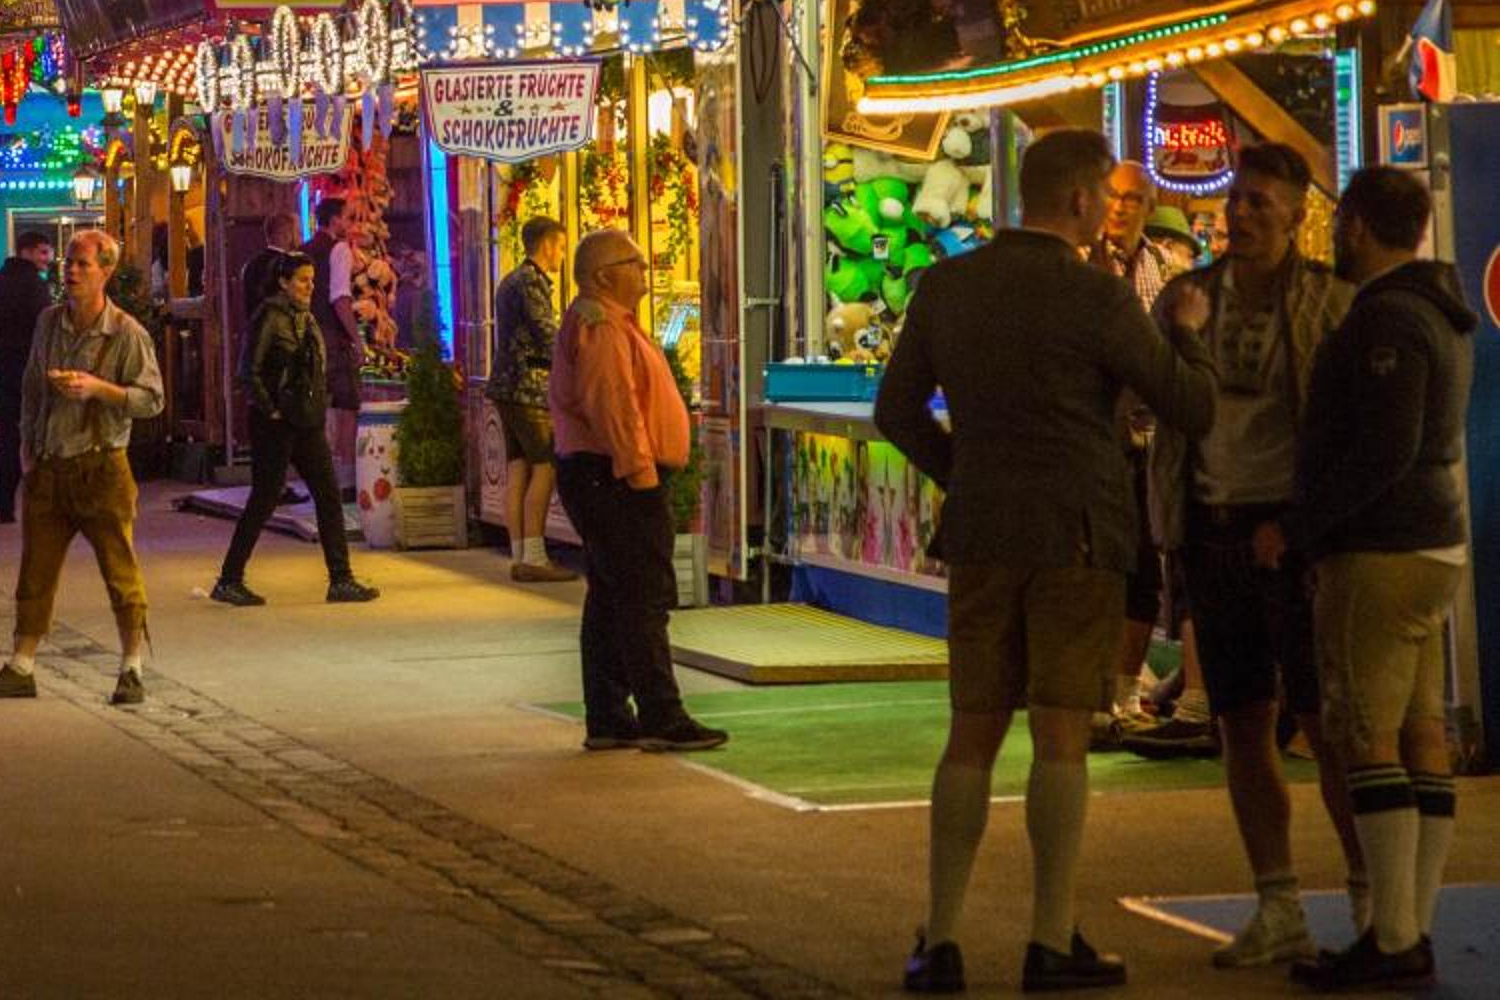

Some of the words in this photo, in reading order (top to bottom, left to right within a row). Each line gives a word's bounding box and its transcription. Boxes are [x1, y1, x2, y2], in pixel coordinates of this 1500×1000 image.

[435, 75, 513, 104] GLASIERTE
[519, 69, 585, 100] FRÜCHTE
[494, 99, 514, 117] &
[443, 112, 581, 151] SCHOKOFRÜCHTE
